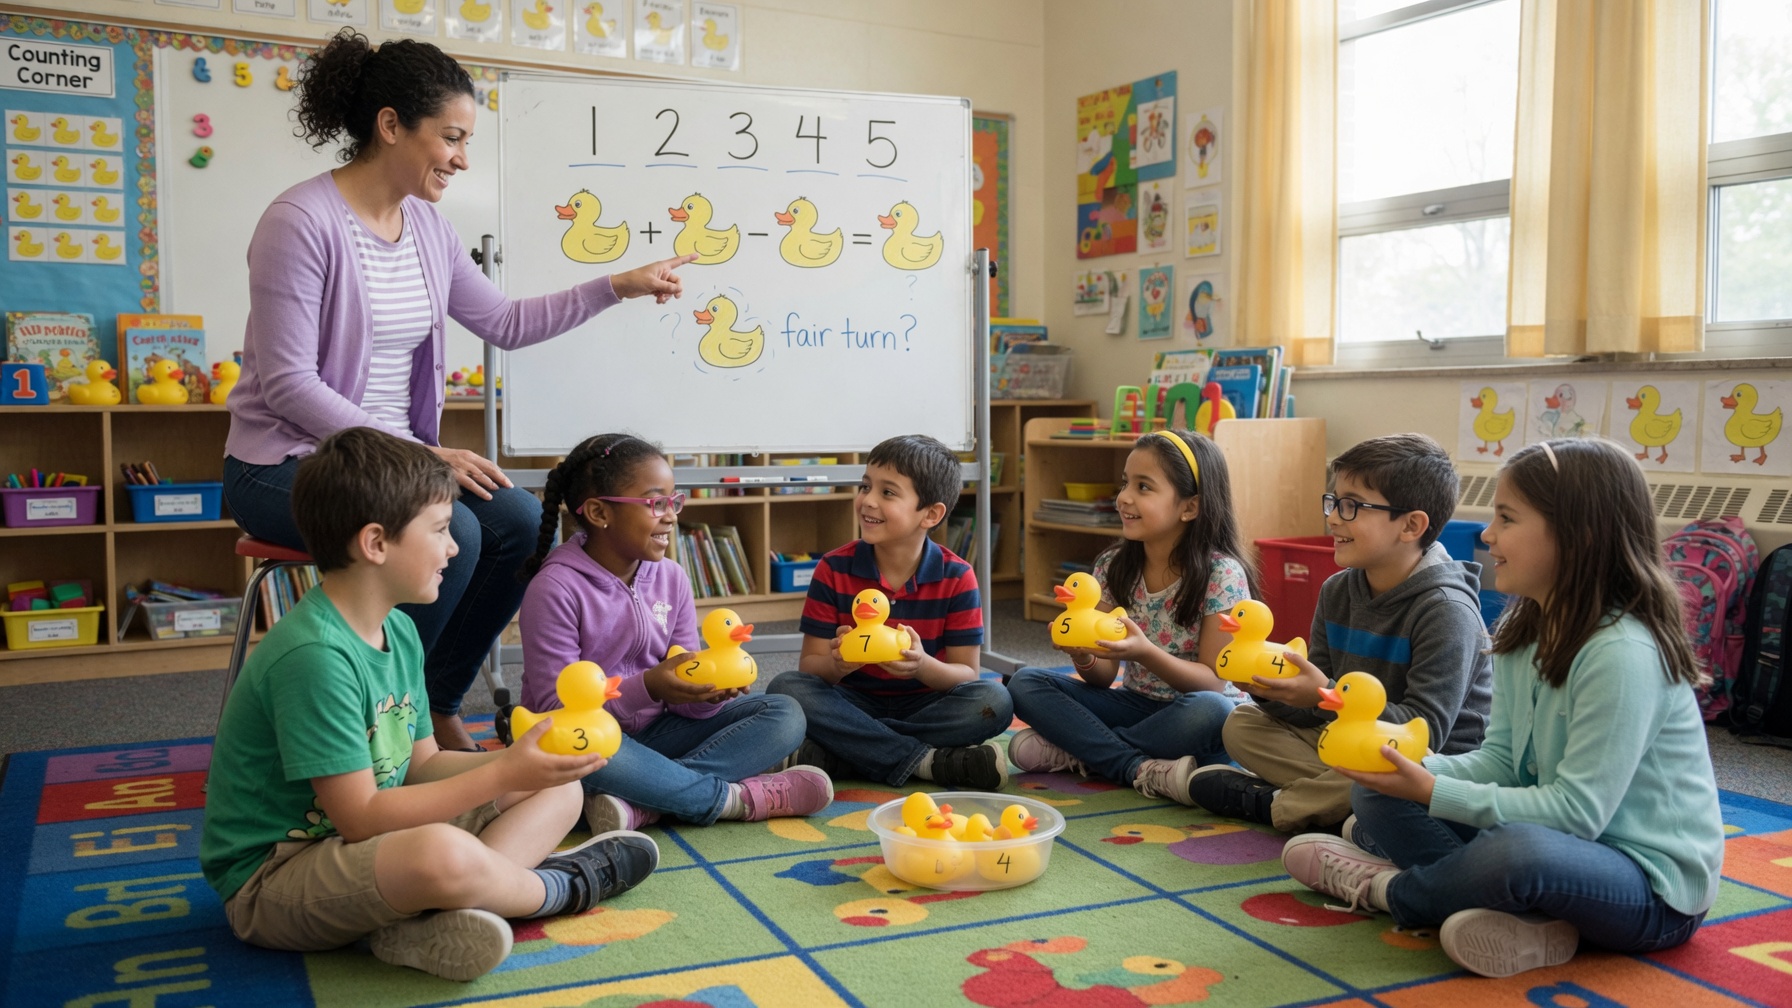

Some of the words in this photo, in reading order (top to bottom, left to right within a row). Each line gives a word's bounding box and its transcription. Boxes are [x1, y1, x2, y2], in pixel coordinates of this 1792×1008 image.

[8, 44, 101, 72] Counting
[17, 67, 93, 88] Corner
[234, 62, 254, 88] 5
[193, 113, 213, 139] 3
[591, 105, 597, 156] 1
[655, 108, 690, 157] 2
[728, 111, 759, 160] 3
[795, 114, 828, 165] 4
[866, 119, 898, 169] 5
[781, 311, 833, 349] fair
[841, 313, 918, 353] turn?
[13, 369, 37, 399] 1
[1059, 617, 1073, 635] 5
[859, 634, 872, 653] 7
[685, 661, 701, 677] 2
[1219, 650, 1232, 668] 5
[1271, 655, 1286, 675] 4
[572, 728, 590, 751] 3
[996, 852, 1013, 875] 4
